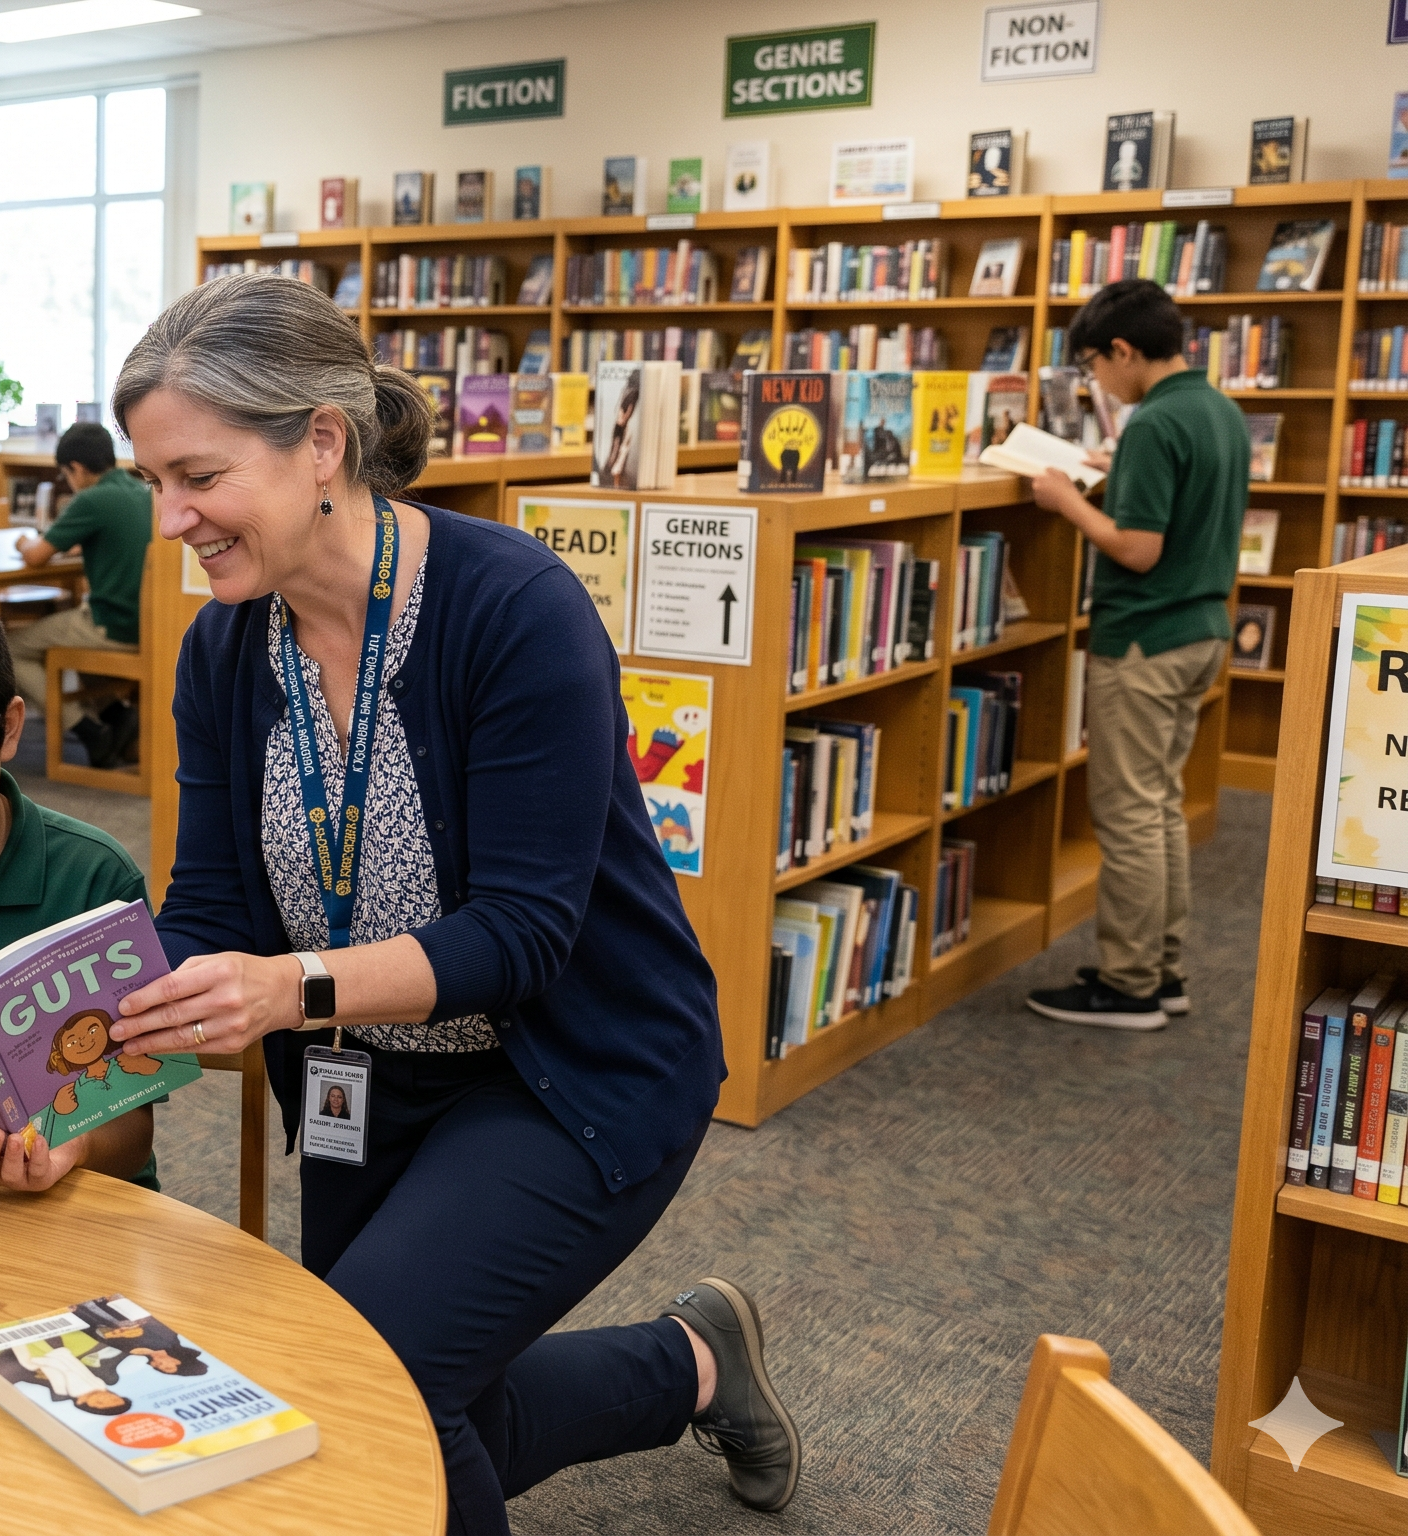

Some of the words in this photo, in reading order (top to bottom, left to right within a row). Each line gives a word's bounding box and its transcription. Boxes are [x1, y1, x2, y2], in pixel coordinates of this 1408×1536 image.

[754, 38, 845, 71] GENRE
[990, 40, 1089, 67] FICTION
[452, 76, 555, 111] FICTION
[732, 68, 864, 105] SECTIONS
[761, 378, 794, 403] NEW
[799, 377, 825, 403] KID
[534, 527, 618, 556] READ!
[666, 518, 730, 537] GENRE
[651, 540, 744, 560] SECTIONS
[0, 939, 142, 1036] GUTS
